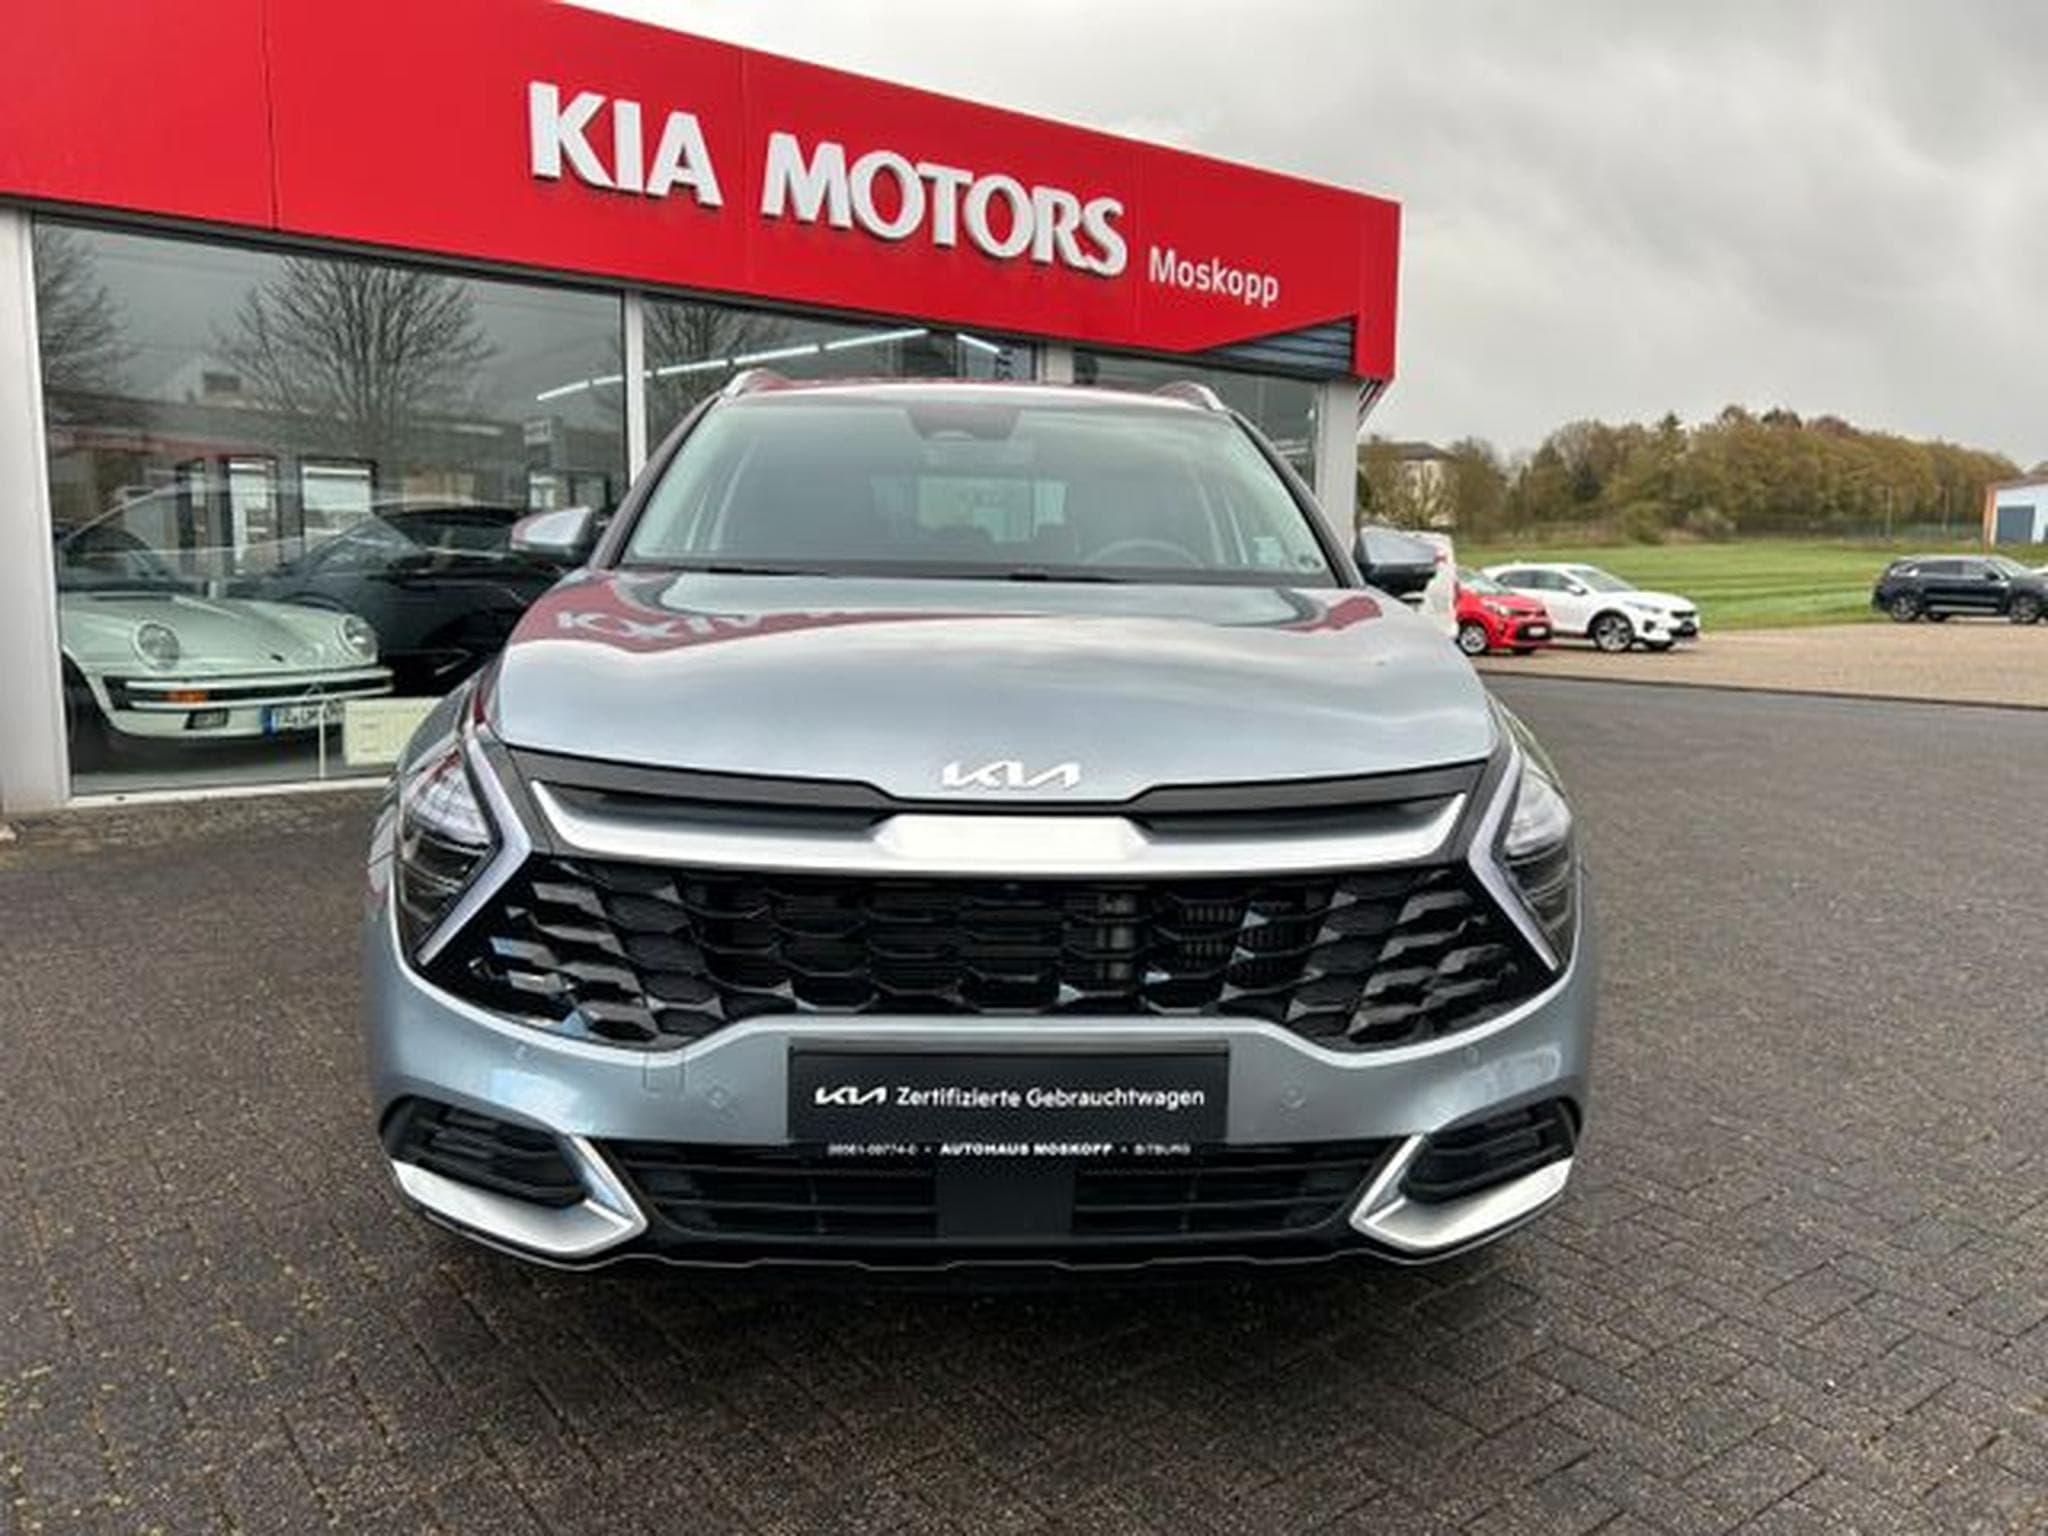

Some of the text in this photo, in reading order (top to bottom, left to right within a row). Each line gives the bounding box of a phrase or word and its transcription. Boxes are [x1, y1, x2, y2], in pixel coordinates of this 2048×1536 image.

[529, 79, 1128, 277] KIA MOTORS
[1149, 246, 1280, 308] Moskopp
[943, 760, 1080, 788] KIA
[814, 1086, 1206, 1111] KIA Zertifizierte Gebrauchtwagen
[940, 1142, 1029, 1157] AUTOHAUS
[1033, 1142, 1113, 1157] MOSKOPP
